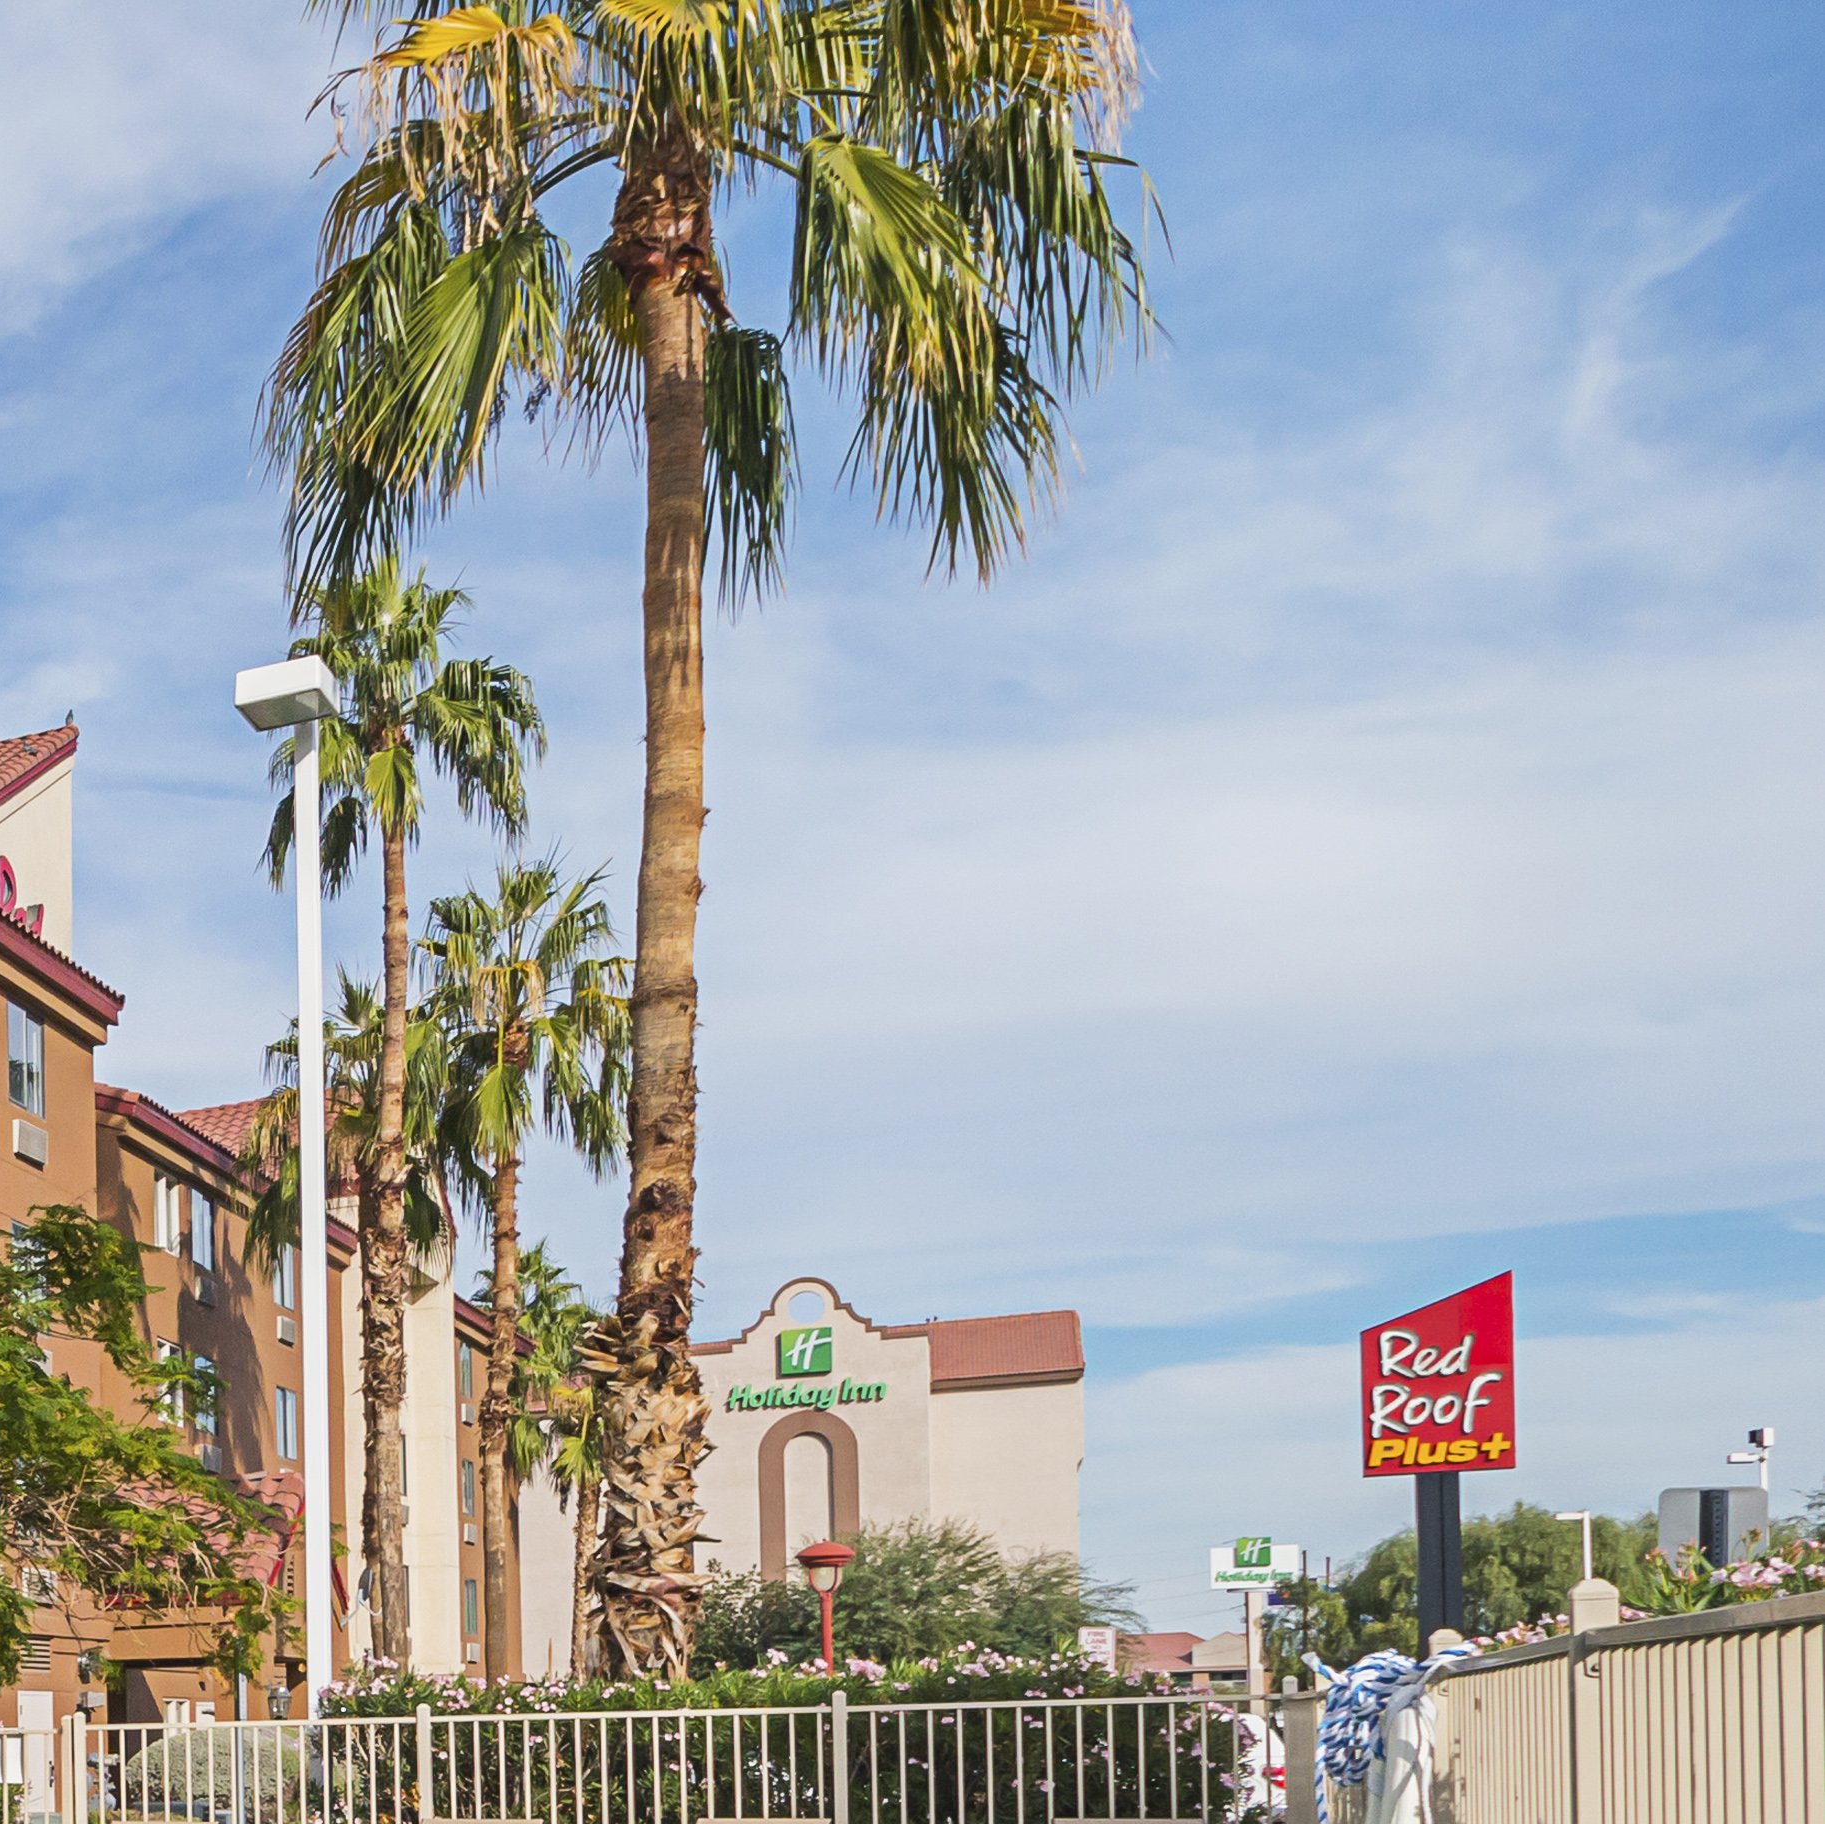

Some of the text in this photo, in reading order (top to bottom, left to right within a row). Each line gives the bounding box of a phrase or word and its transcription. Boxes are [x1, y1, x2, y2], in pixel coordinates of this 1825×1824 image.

[1379, 1330, 1474, 1378] Red
[728, 1376, 887, 1410] Holiday Inn
[1370, 1372, 1503, 1439] Roof
[1367, 1432, 1512, 1468] Plus+
[1214, 1571, 1269, 1584] Holiday
